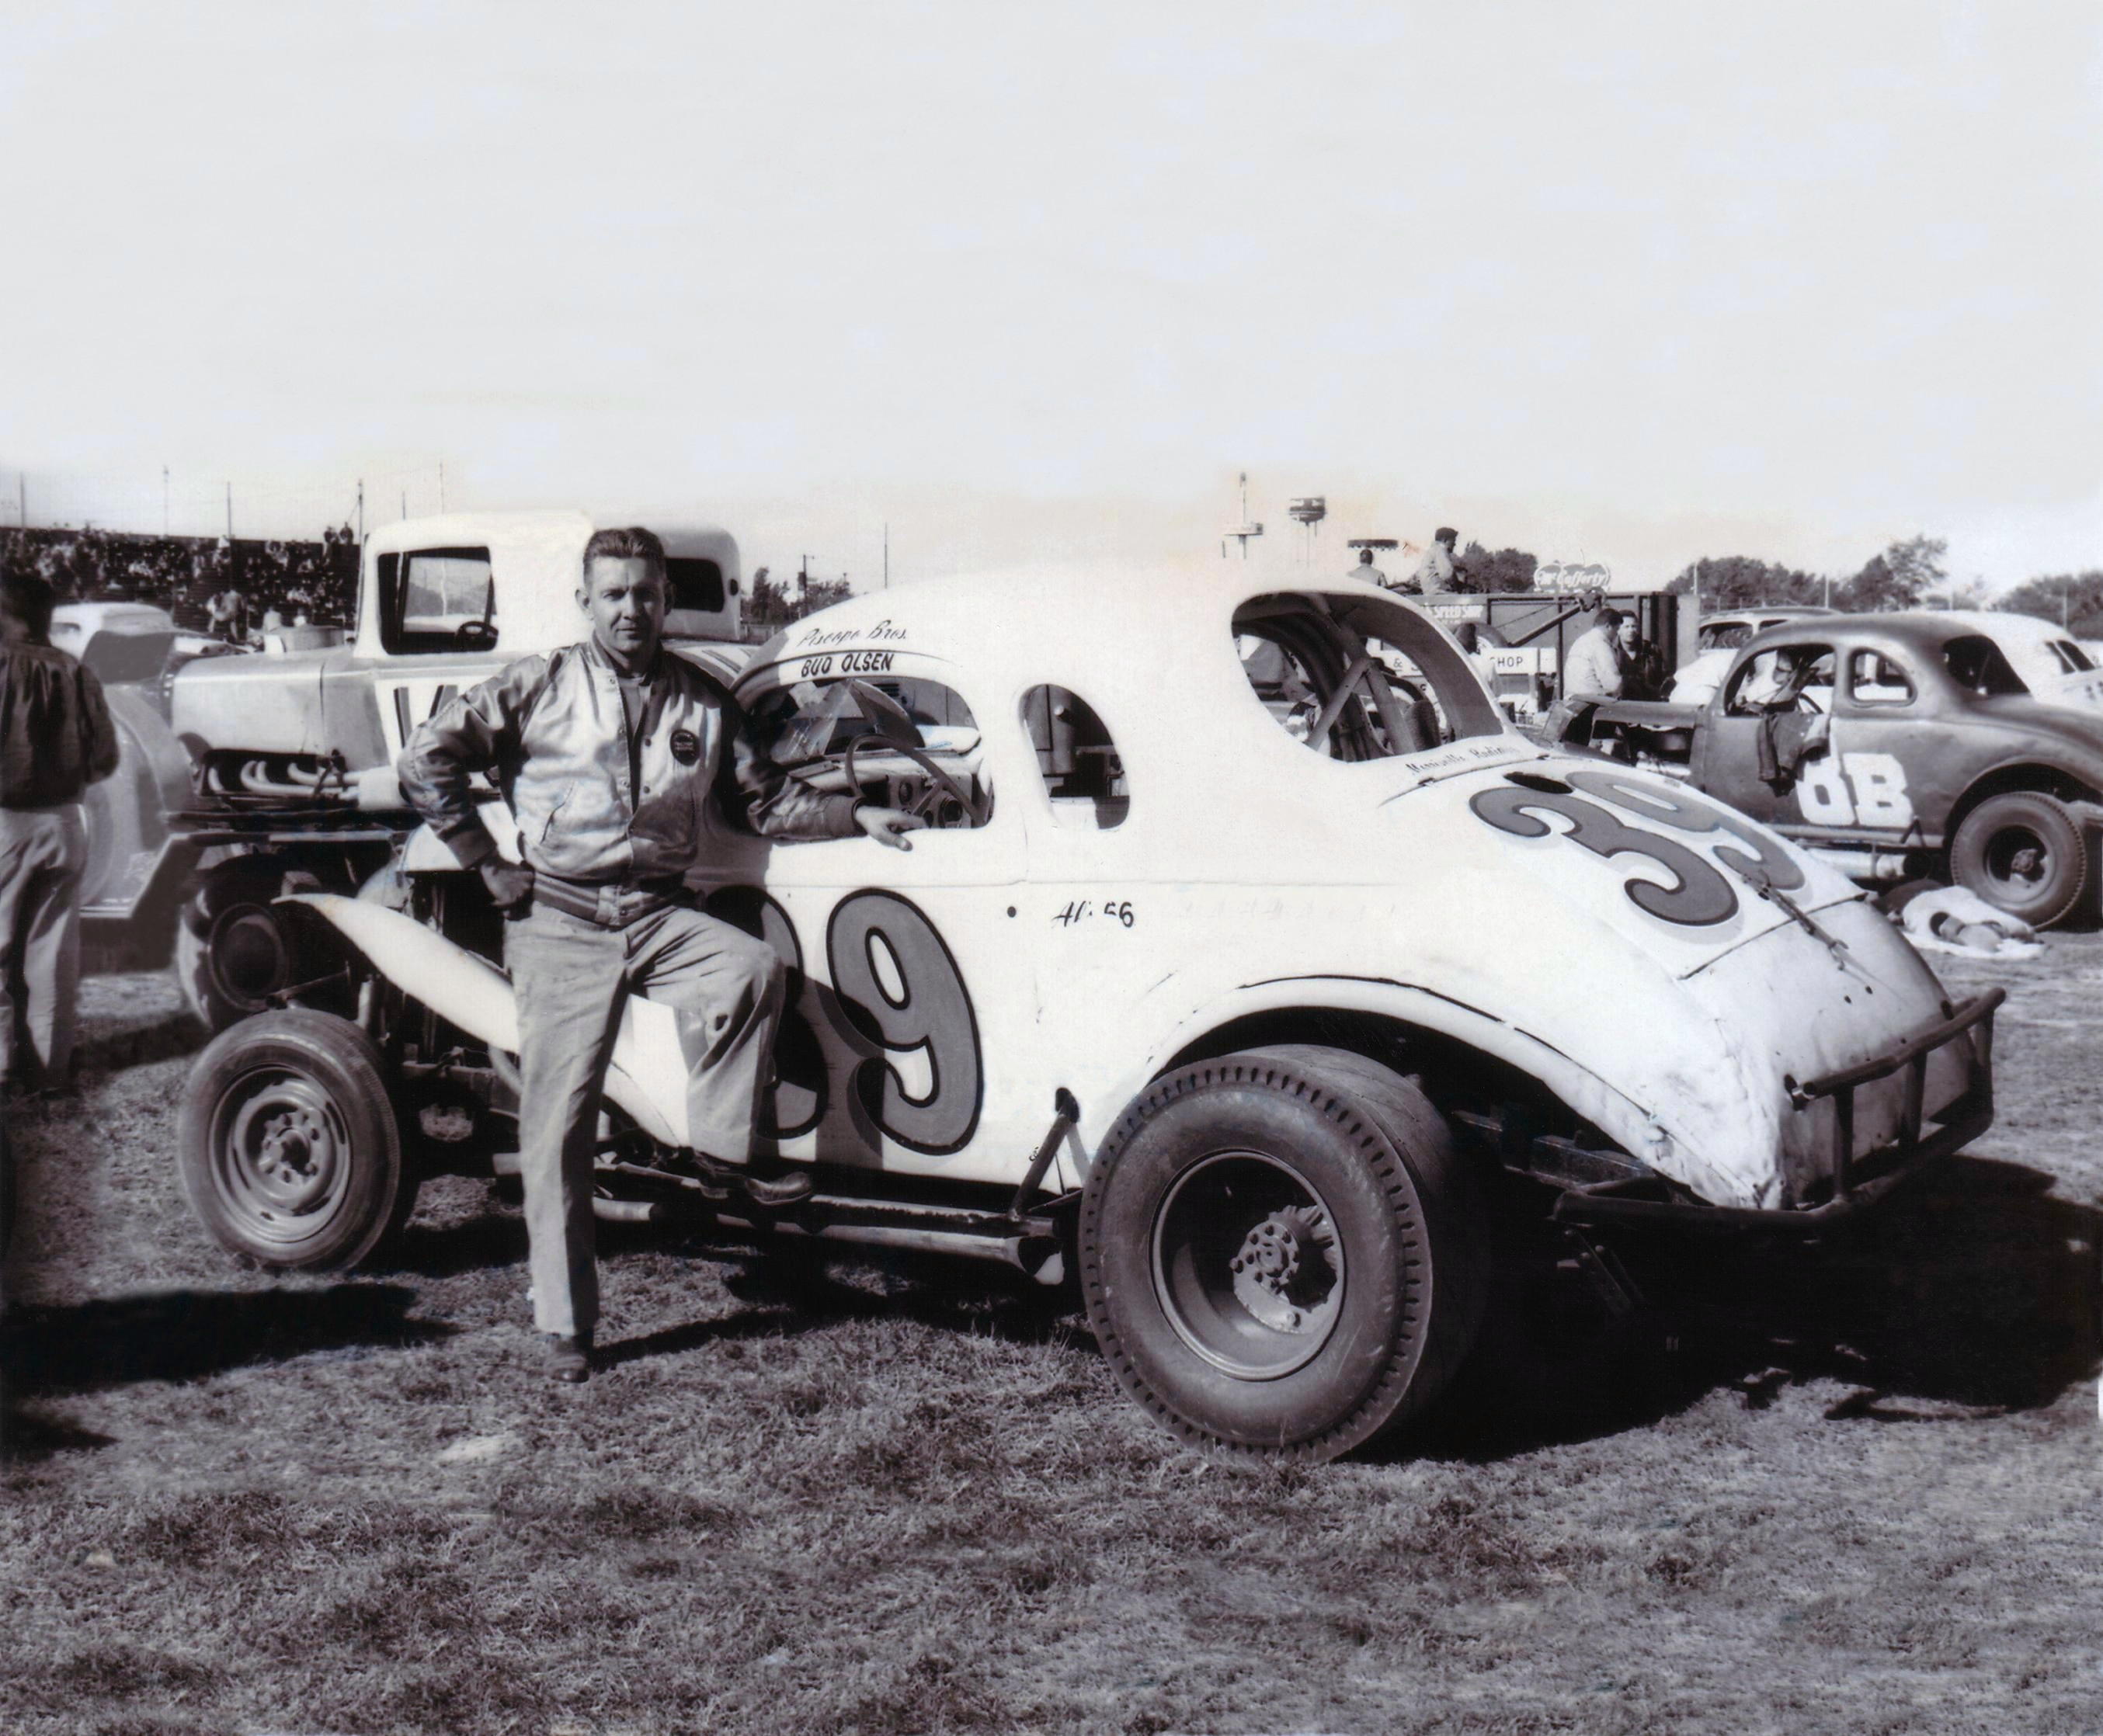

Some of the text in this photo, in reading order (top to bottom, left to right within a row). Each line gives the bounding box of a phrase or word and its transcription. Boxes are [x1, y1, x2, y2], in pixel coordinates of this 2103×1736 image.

[841, 653, 895, 673] OLSEN
[1490, 657, 1523, 668] HOP
[1468, 771, 1806, 927] 39
